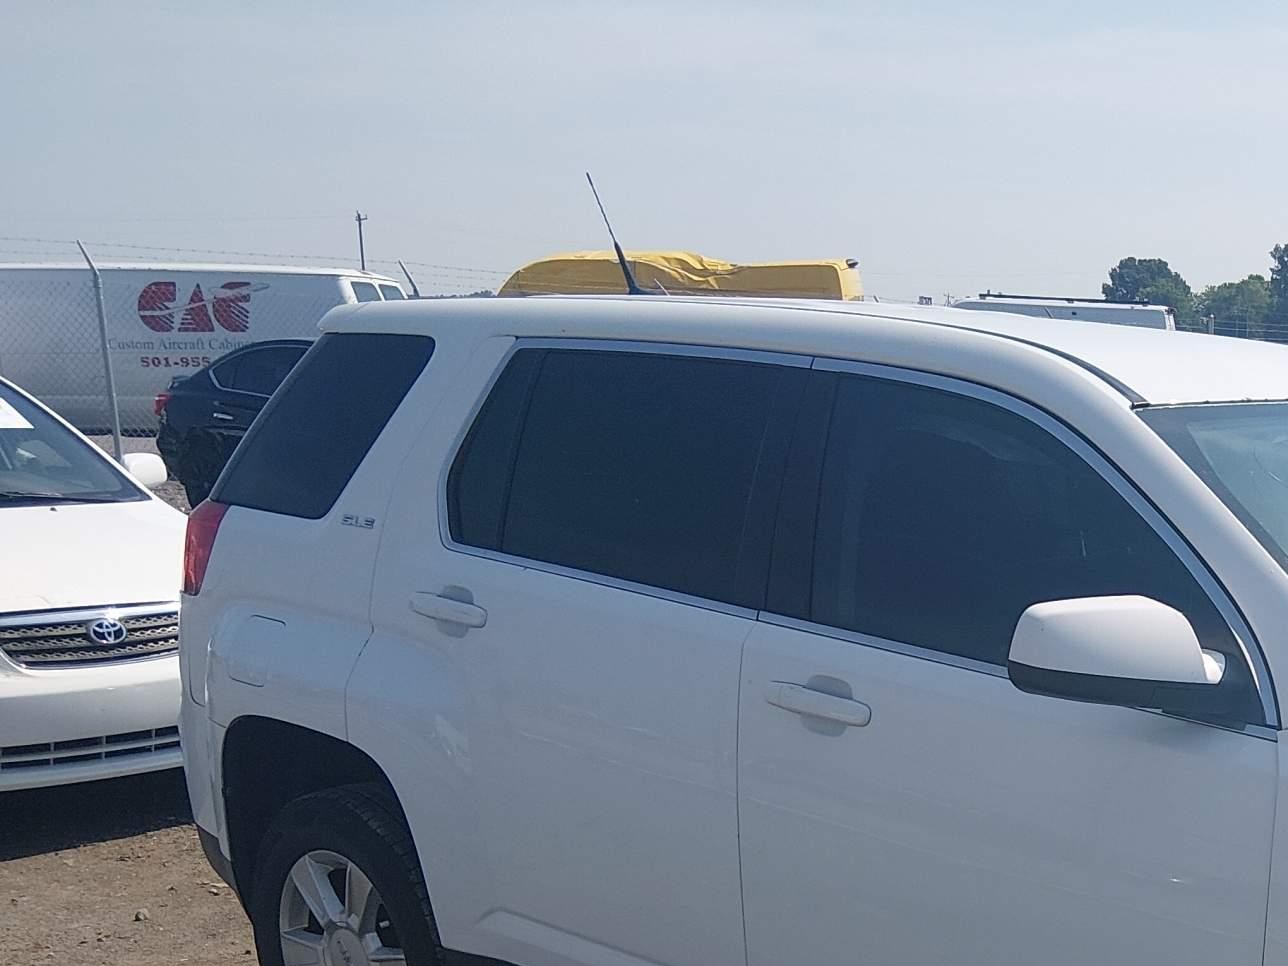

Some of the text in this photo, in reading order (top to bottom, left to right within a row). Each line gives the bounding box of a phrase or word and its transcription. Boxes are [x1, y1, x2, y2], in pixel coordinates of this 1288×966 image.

[109, 338, 155, 351] Custom
[159, 338, 206, 351] Aircraft
[342, 513, 376, 529] SLE
